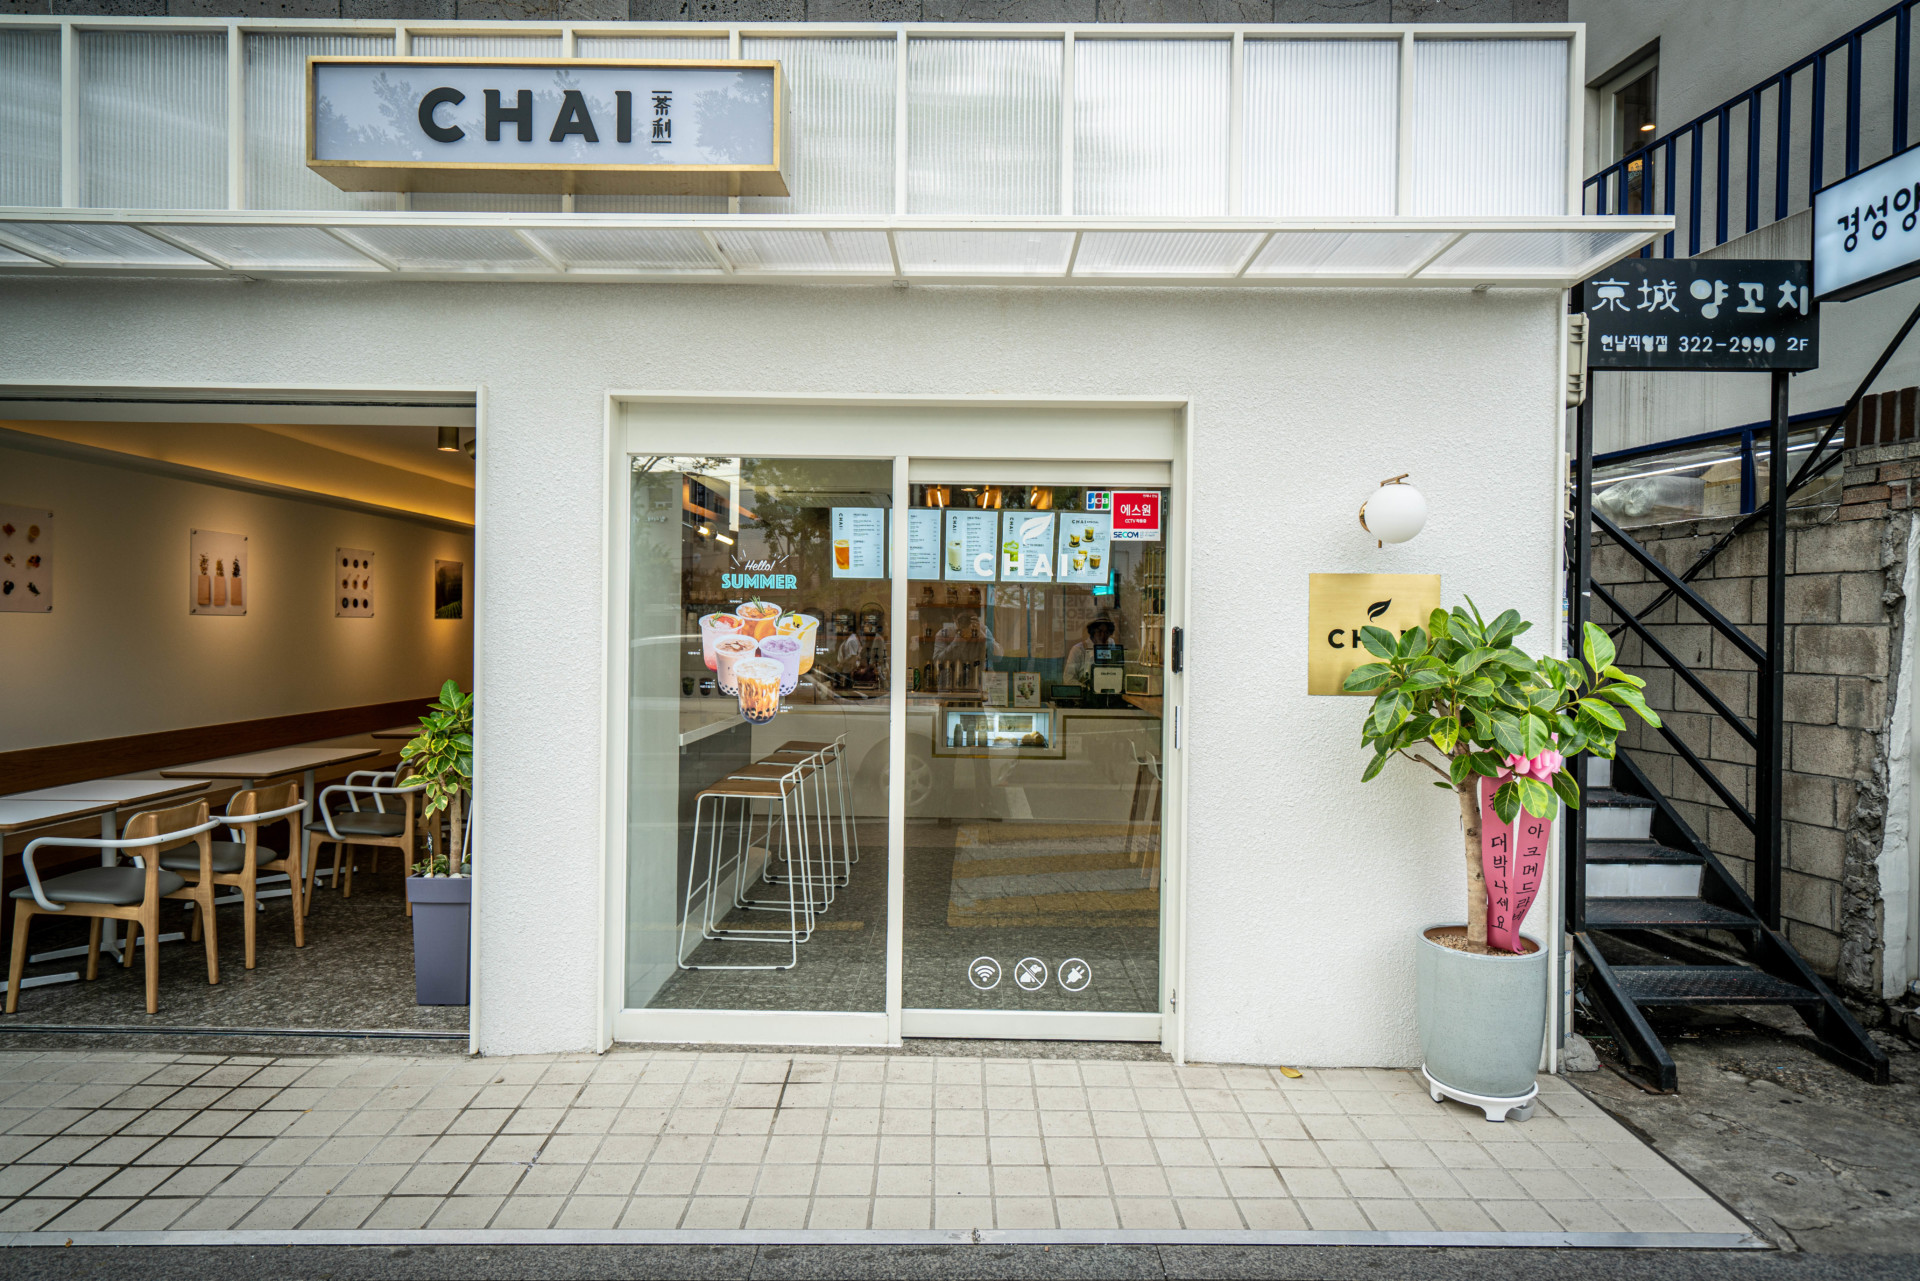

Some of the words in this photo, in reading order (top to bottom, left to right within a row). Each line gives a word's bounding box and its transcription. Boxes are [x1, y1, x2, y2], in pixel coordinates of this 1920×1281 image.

[418, 86, 632, 143] CHAI
[651, 95, 672, 139] 茶利
[1679, 336, 1776, 353] 322-2990
[1787, 337, 1809, 351] 2F
[1087, 497, 1109, 505] JCB
[1120, 503, 1151, 517] 에스원
[1113, 531, 1139, 539] SECOM
[744, 559, 776, 571] Hello!
[973, 552, 1069, 577] CHAI
[721, 573, 798, 590] SUMMER
